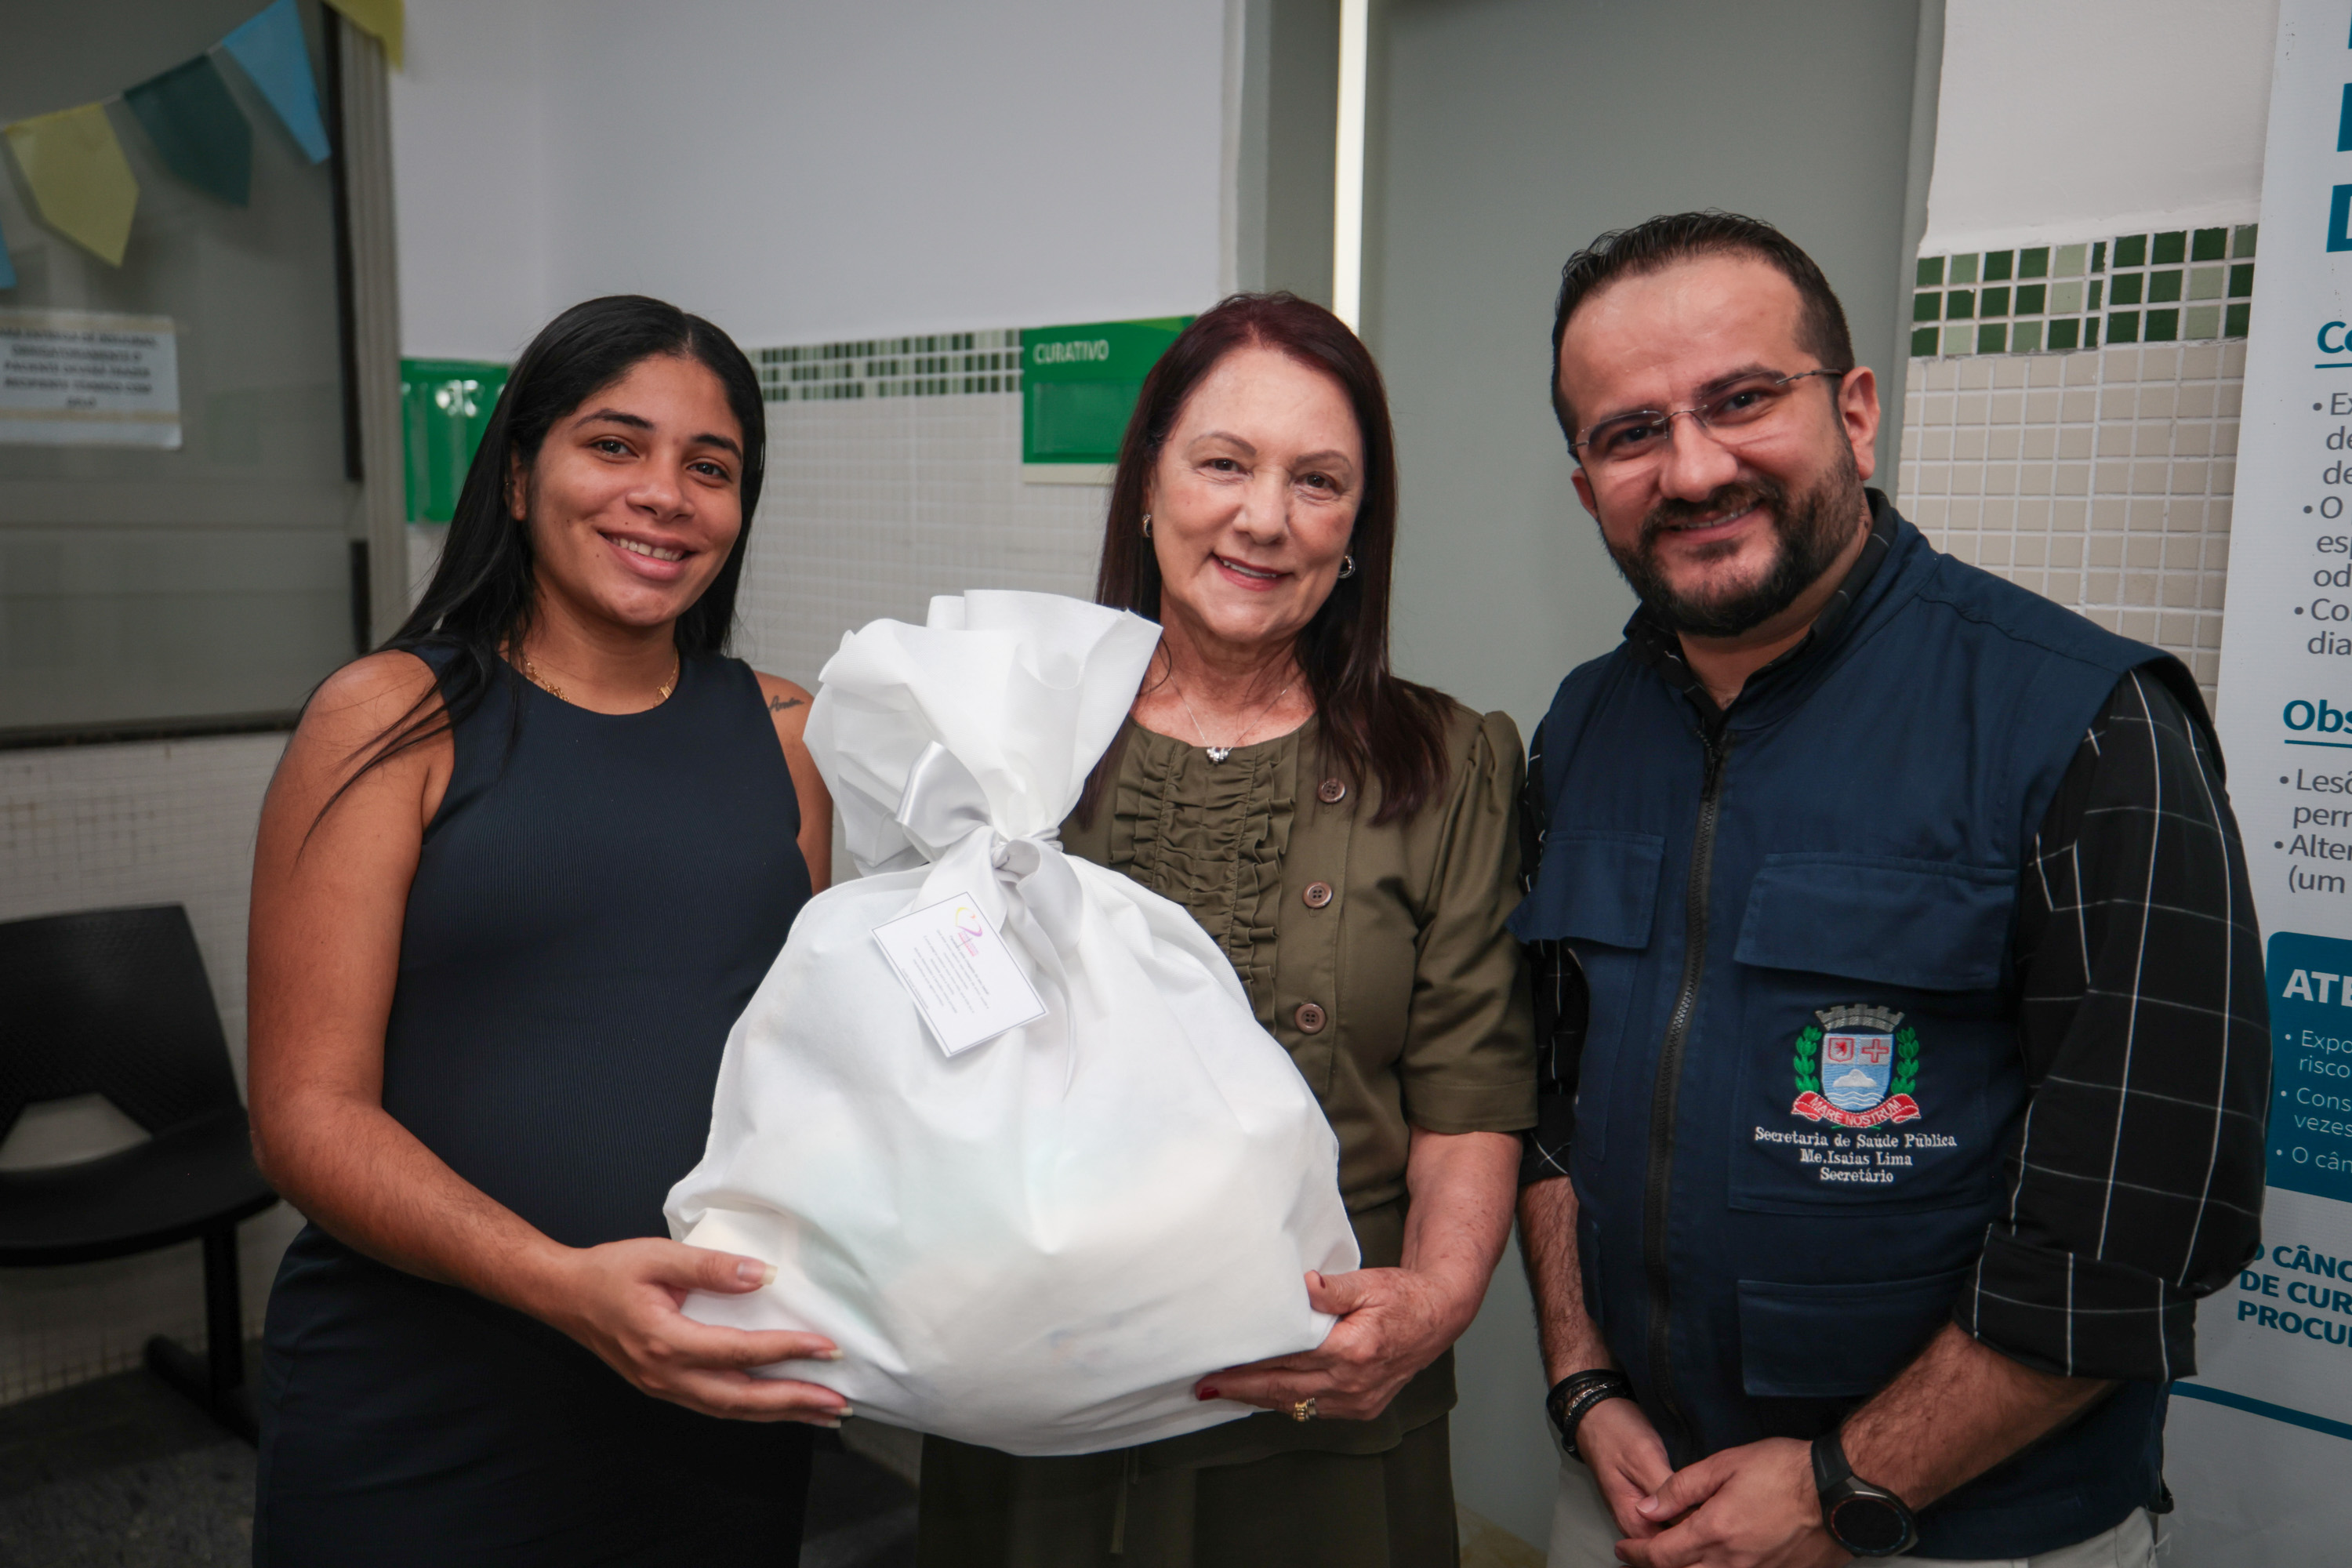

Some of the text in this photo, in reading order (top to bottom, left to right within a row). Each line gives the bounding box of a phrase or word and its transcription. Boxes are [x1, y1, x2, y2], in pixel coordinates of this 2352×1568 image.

[1033, 339, 1109, 365] CURATIVO
[2320, 495, 2343, 519] O
[2317, 535, 2352, 561] es
[2310, 598, 2352, 622] Co
[2288, 865, 2346, 894] (um
[2299, 1054, 2350, 1078] risco
[1809, 1097, 1901, 1125] MARE NOSTRUM
[2296, 1087, 2352, 1112] Cons
[1755, 1127, 1829, 1148] Secretaria
[1834, 1134, 1850, 1147] de
[1876, 1152, 1913, 1166] Lima
[2292, 1146, 2309, 1164] O
[1820, 1167, 1894, 1183] Secretário
[2240, 1269, 2280, 1298] DE
[2238, 1300, 2352, 1348] PROCU
